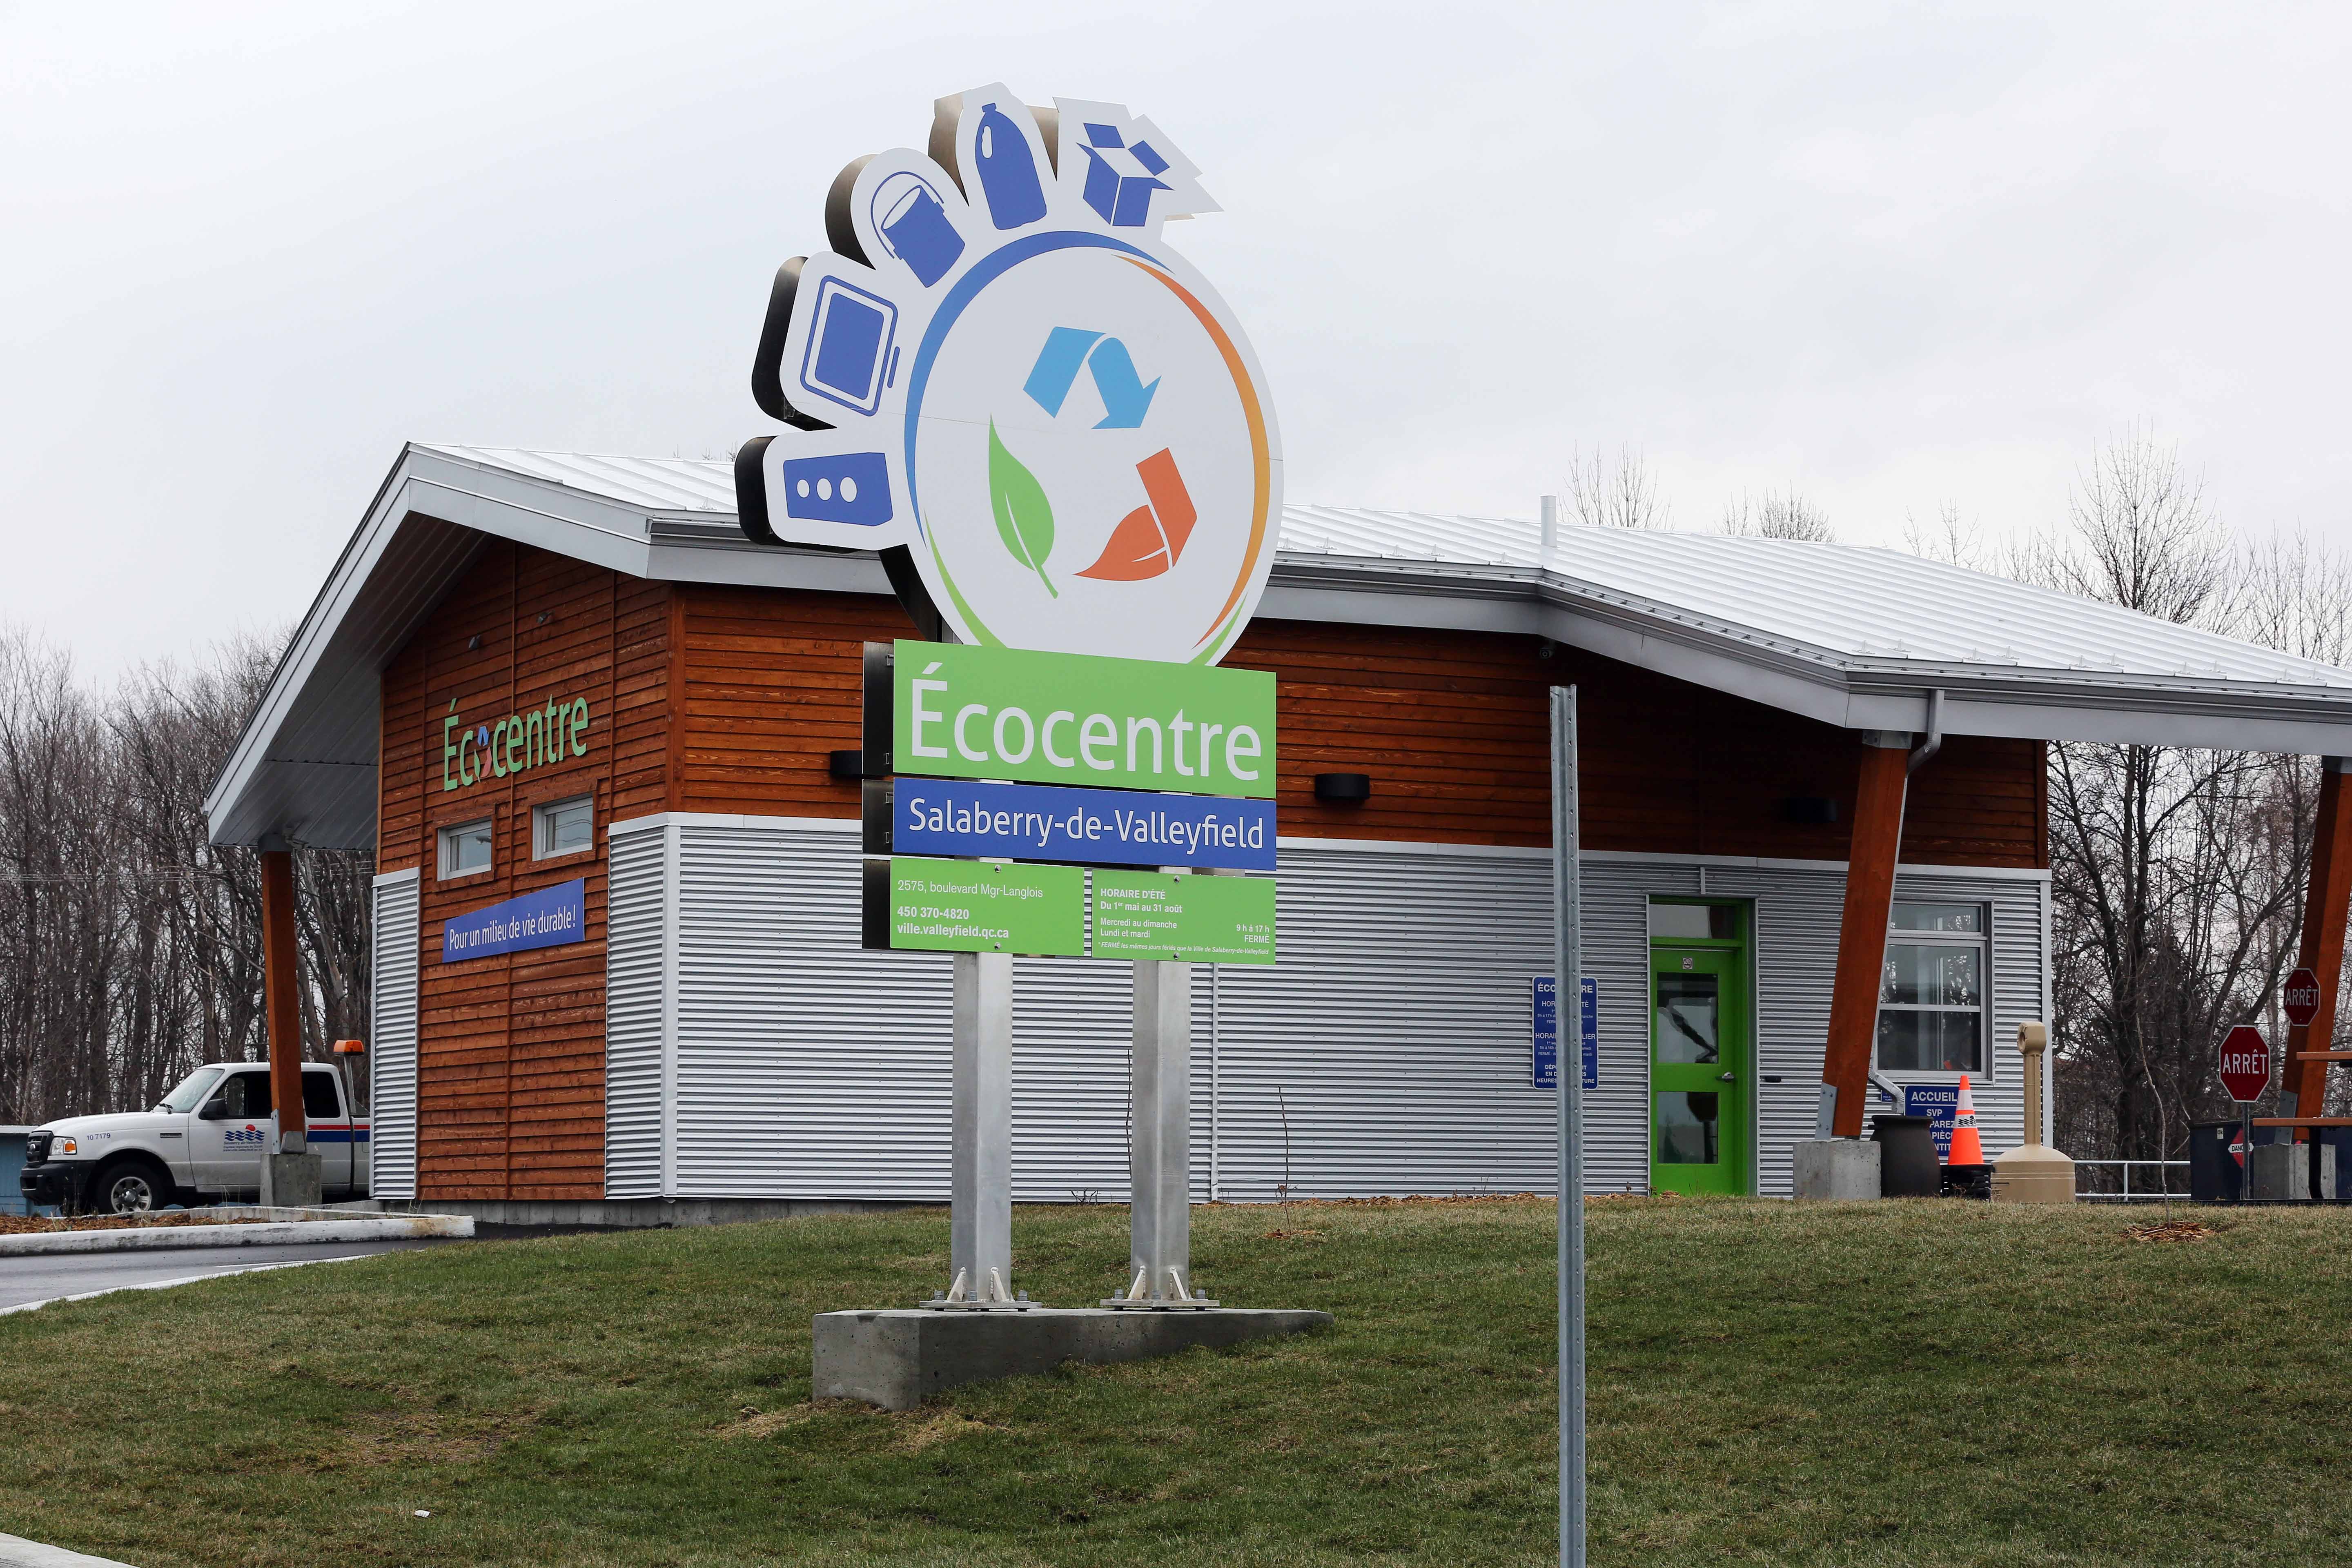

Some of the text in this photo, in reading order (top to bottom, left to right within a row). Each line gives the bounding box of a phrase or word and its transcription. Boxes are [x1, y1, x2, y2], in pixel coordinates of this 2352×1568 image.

[912, 662, 1261, 780] Écocentre
[909, 798, 1263, 855] Salaberry-de-Valleyfield
[898, 880, 1043, 899] 2575, boulevard Mgr-Langlois
[1100, 888, 1166, 900] HORAIRE D'ÉTÉ
[898, 906, 969, 920] 450 370-4820
[1100, 901, 1111, 910] Du
[1114, 902, 1123, 910] 1er
[1125, 903, 1139, 911] mai
[1153, 904, 1162, 912] 31
[1164, 904, 1183, 913] août
[1100, 918, 1131, 927] Mercredi
[1143, 920, 1177, 929] dimanche
[450, 929, 468, 951] Pour
[470, 929, 480, 947] un
[482, 920, 507, 944] milieu
[509, 915, 520, 939] de
[522, 912, 536, 937] vie
[898, 923, 1009, 939] ville.valleyfield.qc.ca
[1100, 928, 1119, 936] Lundi
[1244, 934, 1270, 943] FERMÉ
[1212, 947, 1269, 955] Salaberry-de-Valleyfield
[2285, 985, 2318, 1006] ARRÊT
[2223, 1049, 2267, 1074] ARRÊT
[1911, 1091, 1957, 1102] ACCUEIL
